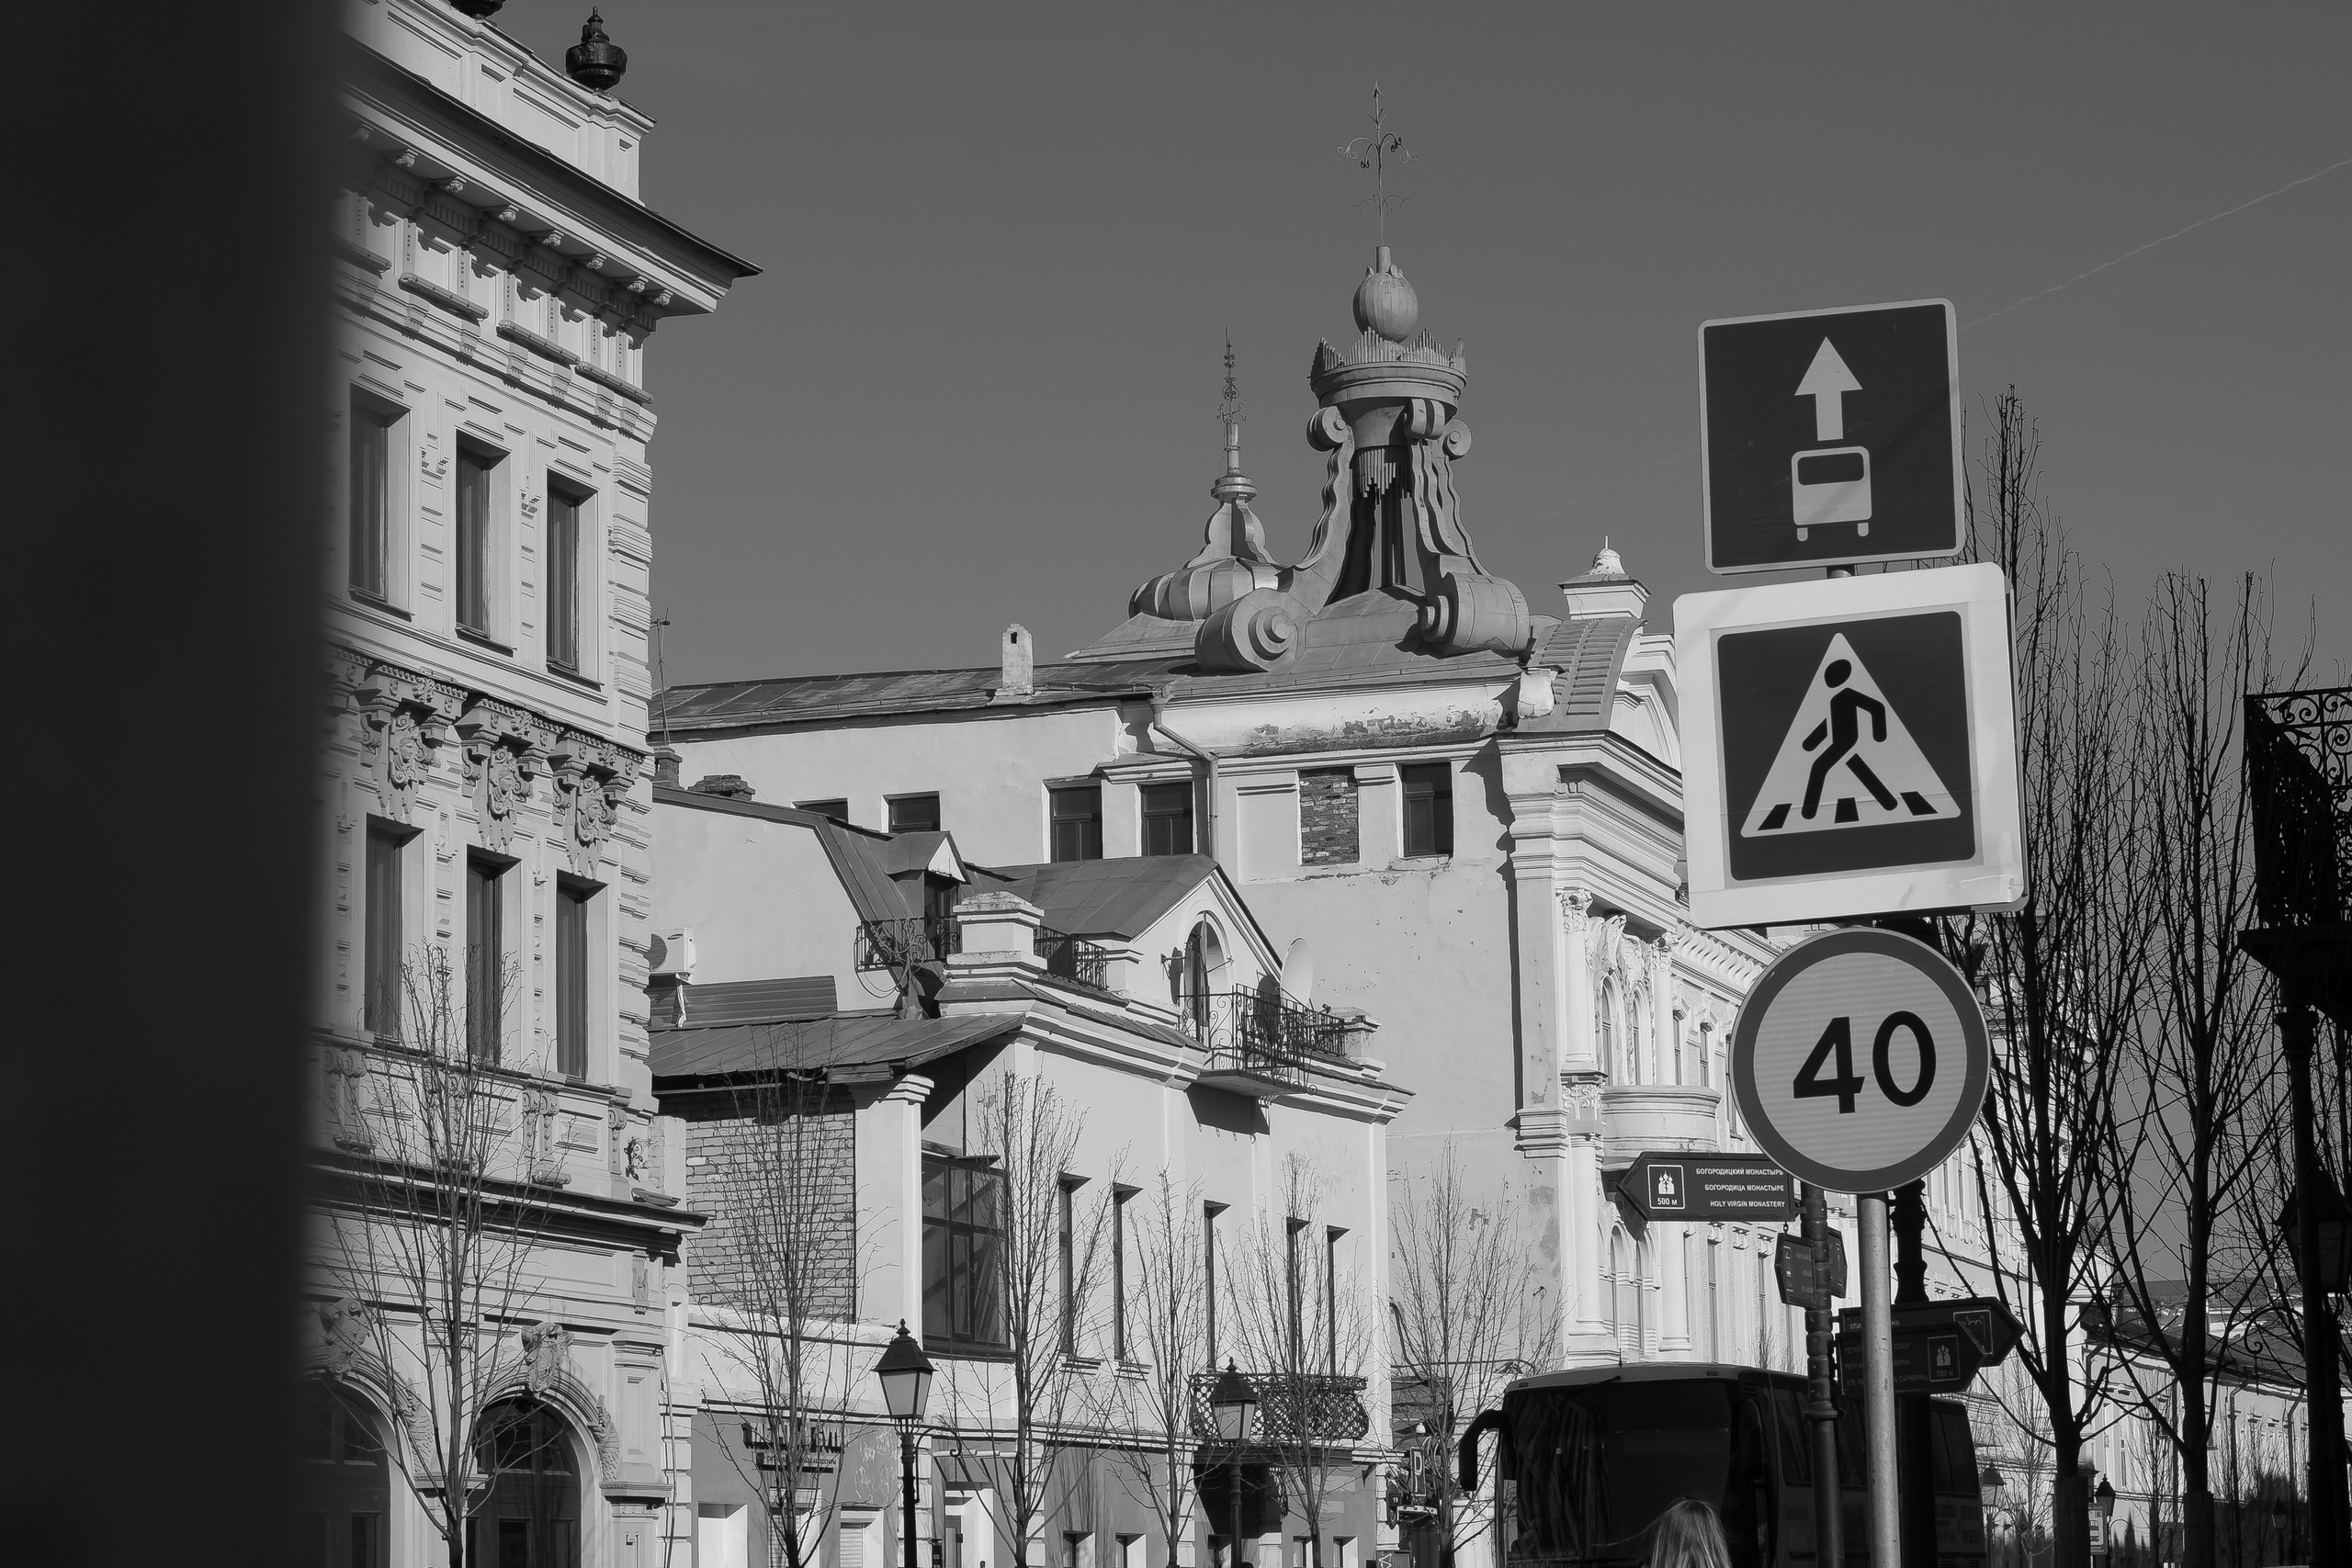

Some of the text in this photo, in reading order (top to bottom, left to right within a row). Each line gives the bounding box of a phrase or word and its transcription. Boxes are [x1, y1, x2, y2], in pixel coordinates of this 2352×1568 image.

[1793, 1010, 1936, 1114] 40
[1695, 1168, 1745, 1176] БОГОРОДИЦКИЙ
[1704, 1184, 1746, 1192] БОГОРОДИЦА
[1657, 1197, 1670, 1205] 500
